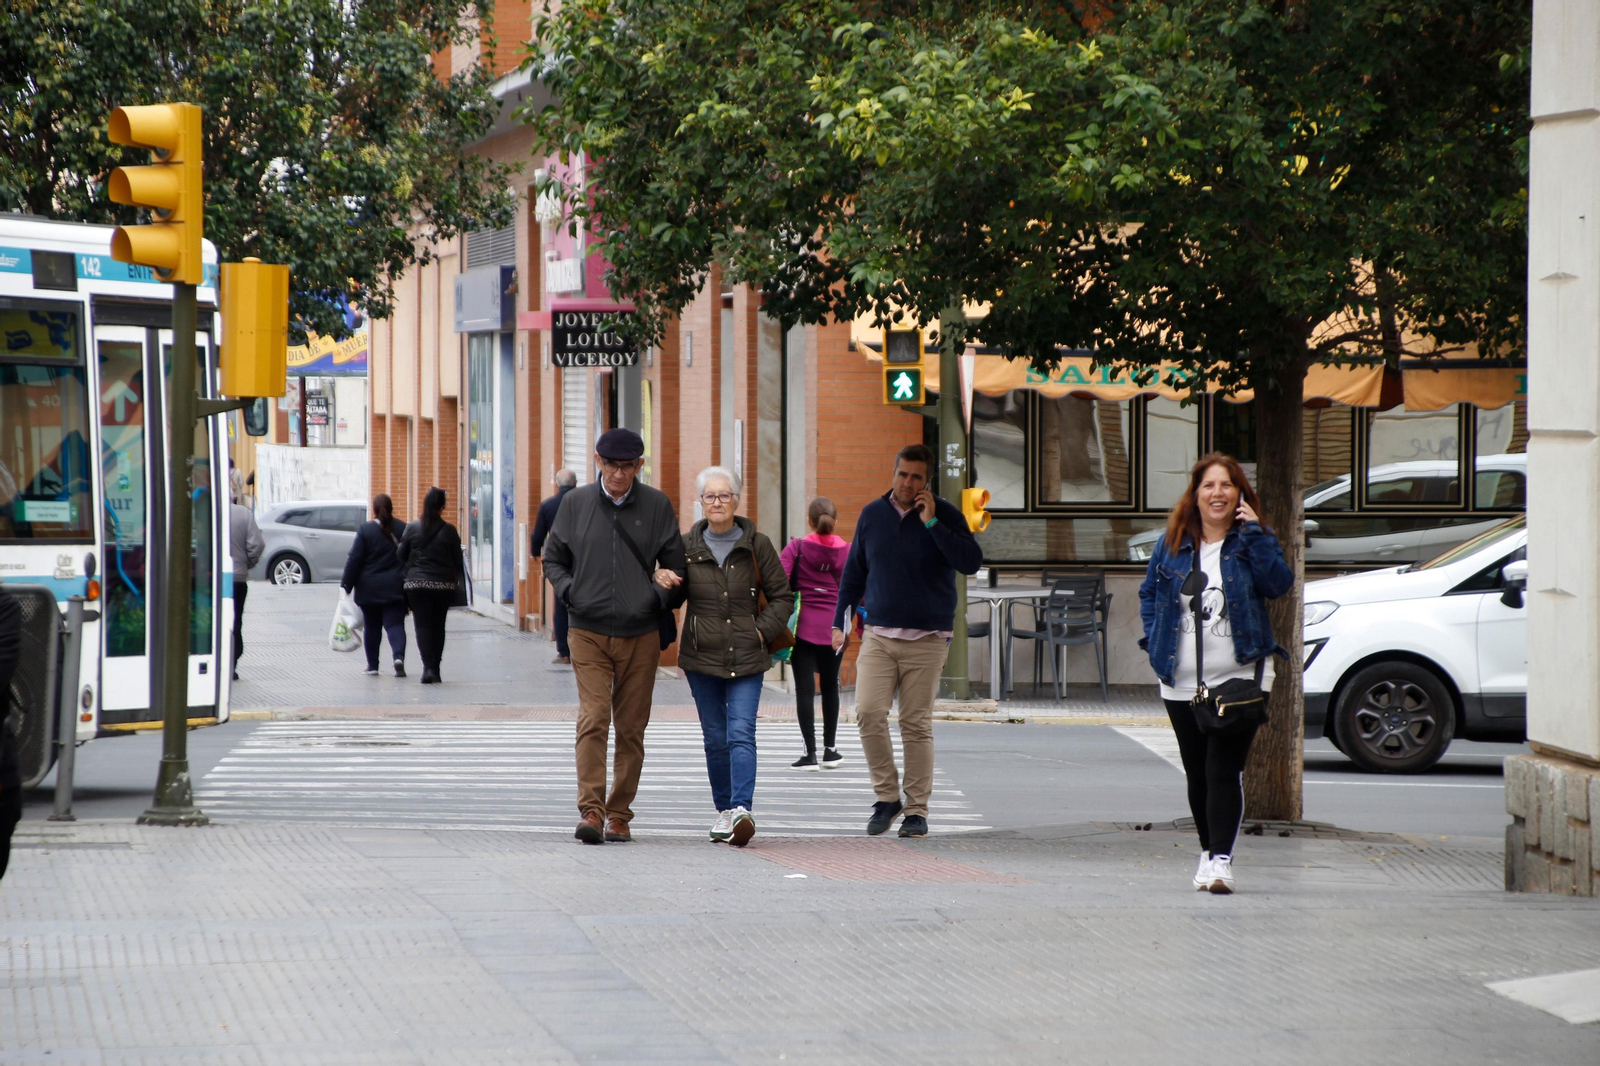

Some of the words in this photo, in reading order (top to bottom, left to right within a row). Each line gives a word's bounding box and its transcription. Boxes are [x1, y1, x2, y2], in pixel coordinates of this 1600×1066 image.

[81, 256, 102, 276] 142
[566, 333, 624, 347] LOTUS
[309, 342, 321, 357] DE
[555, 352, 636, 366] VICEROY
